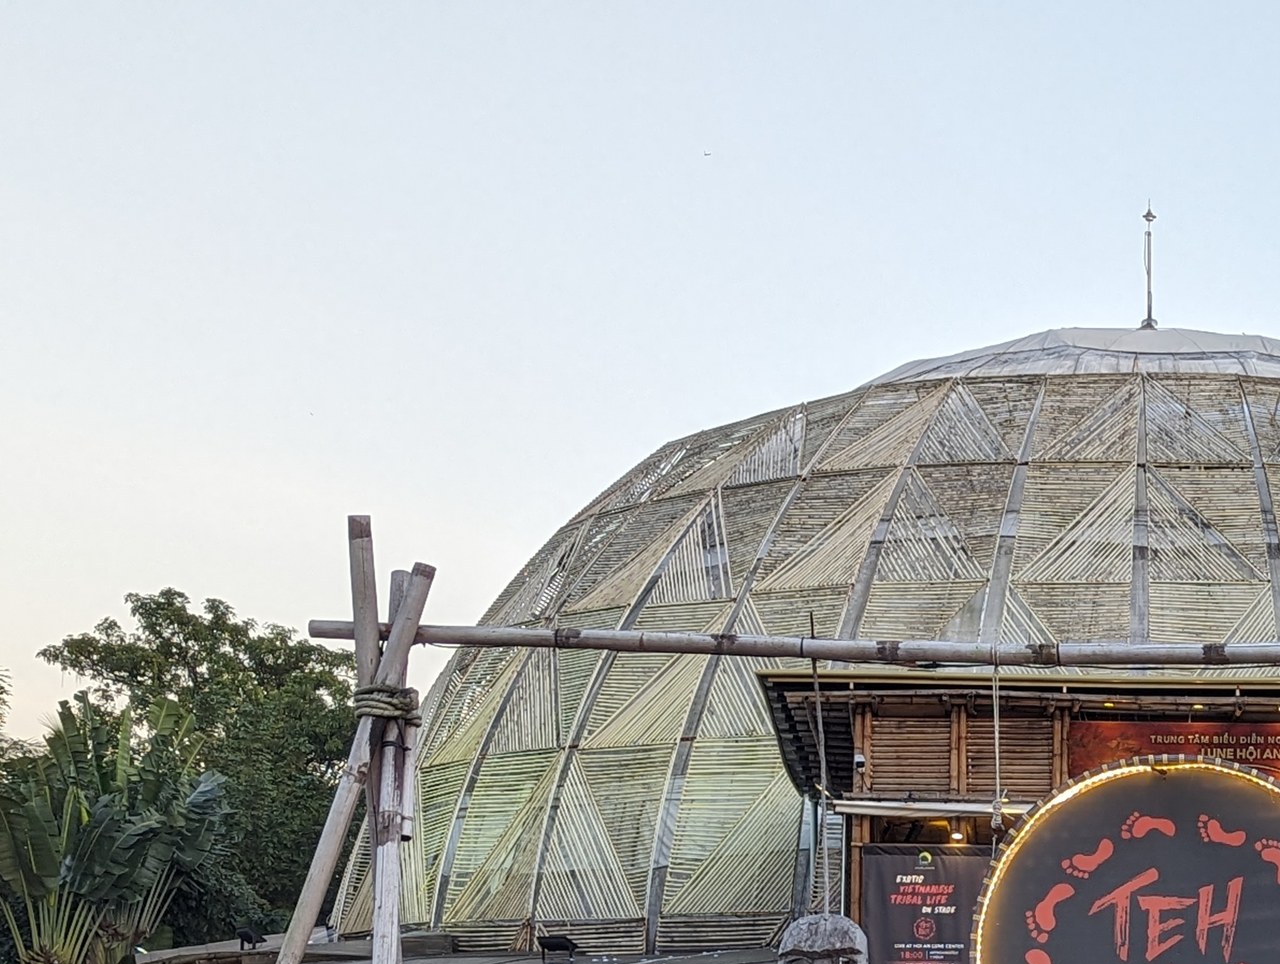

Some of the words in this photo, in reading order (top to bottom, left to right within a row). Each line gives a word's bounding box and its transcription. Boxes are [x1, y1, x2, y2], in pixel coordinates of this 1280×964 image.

[1150, 736, 1185, 744] TRUNG
[1188, 734, 1209, 744] TÂM
[1201, 748, 1234, 759] LUNE
[1236, 746, 1260, 761] HỘI
[896, 875, 925, 883] EXOTIC
[900, 884, 955, 894] VIETNAMESE
[890, 894, 922, 904] TRIBAL
[926, 895, 948, 904] LIFE
[922, 906, 932, 914] ON
[934, 906, 956, 914] STAGE
[1088, 867, 1243, 963] TEH
[901, 951, 923, 959] 18:00
